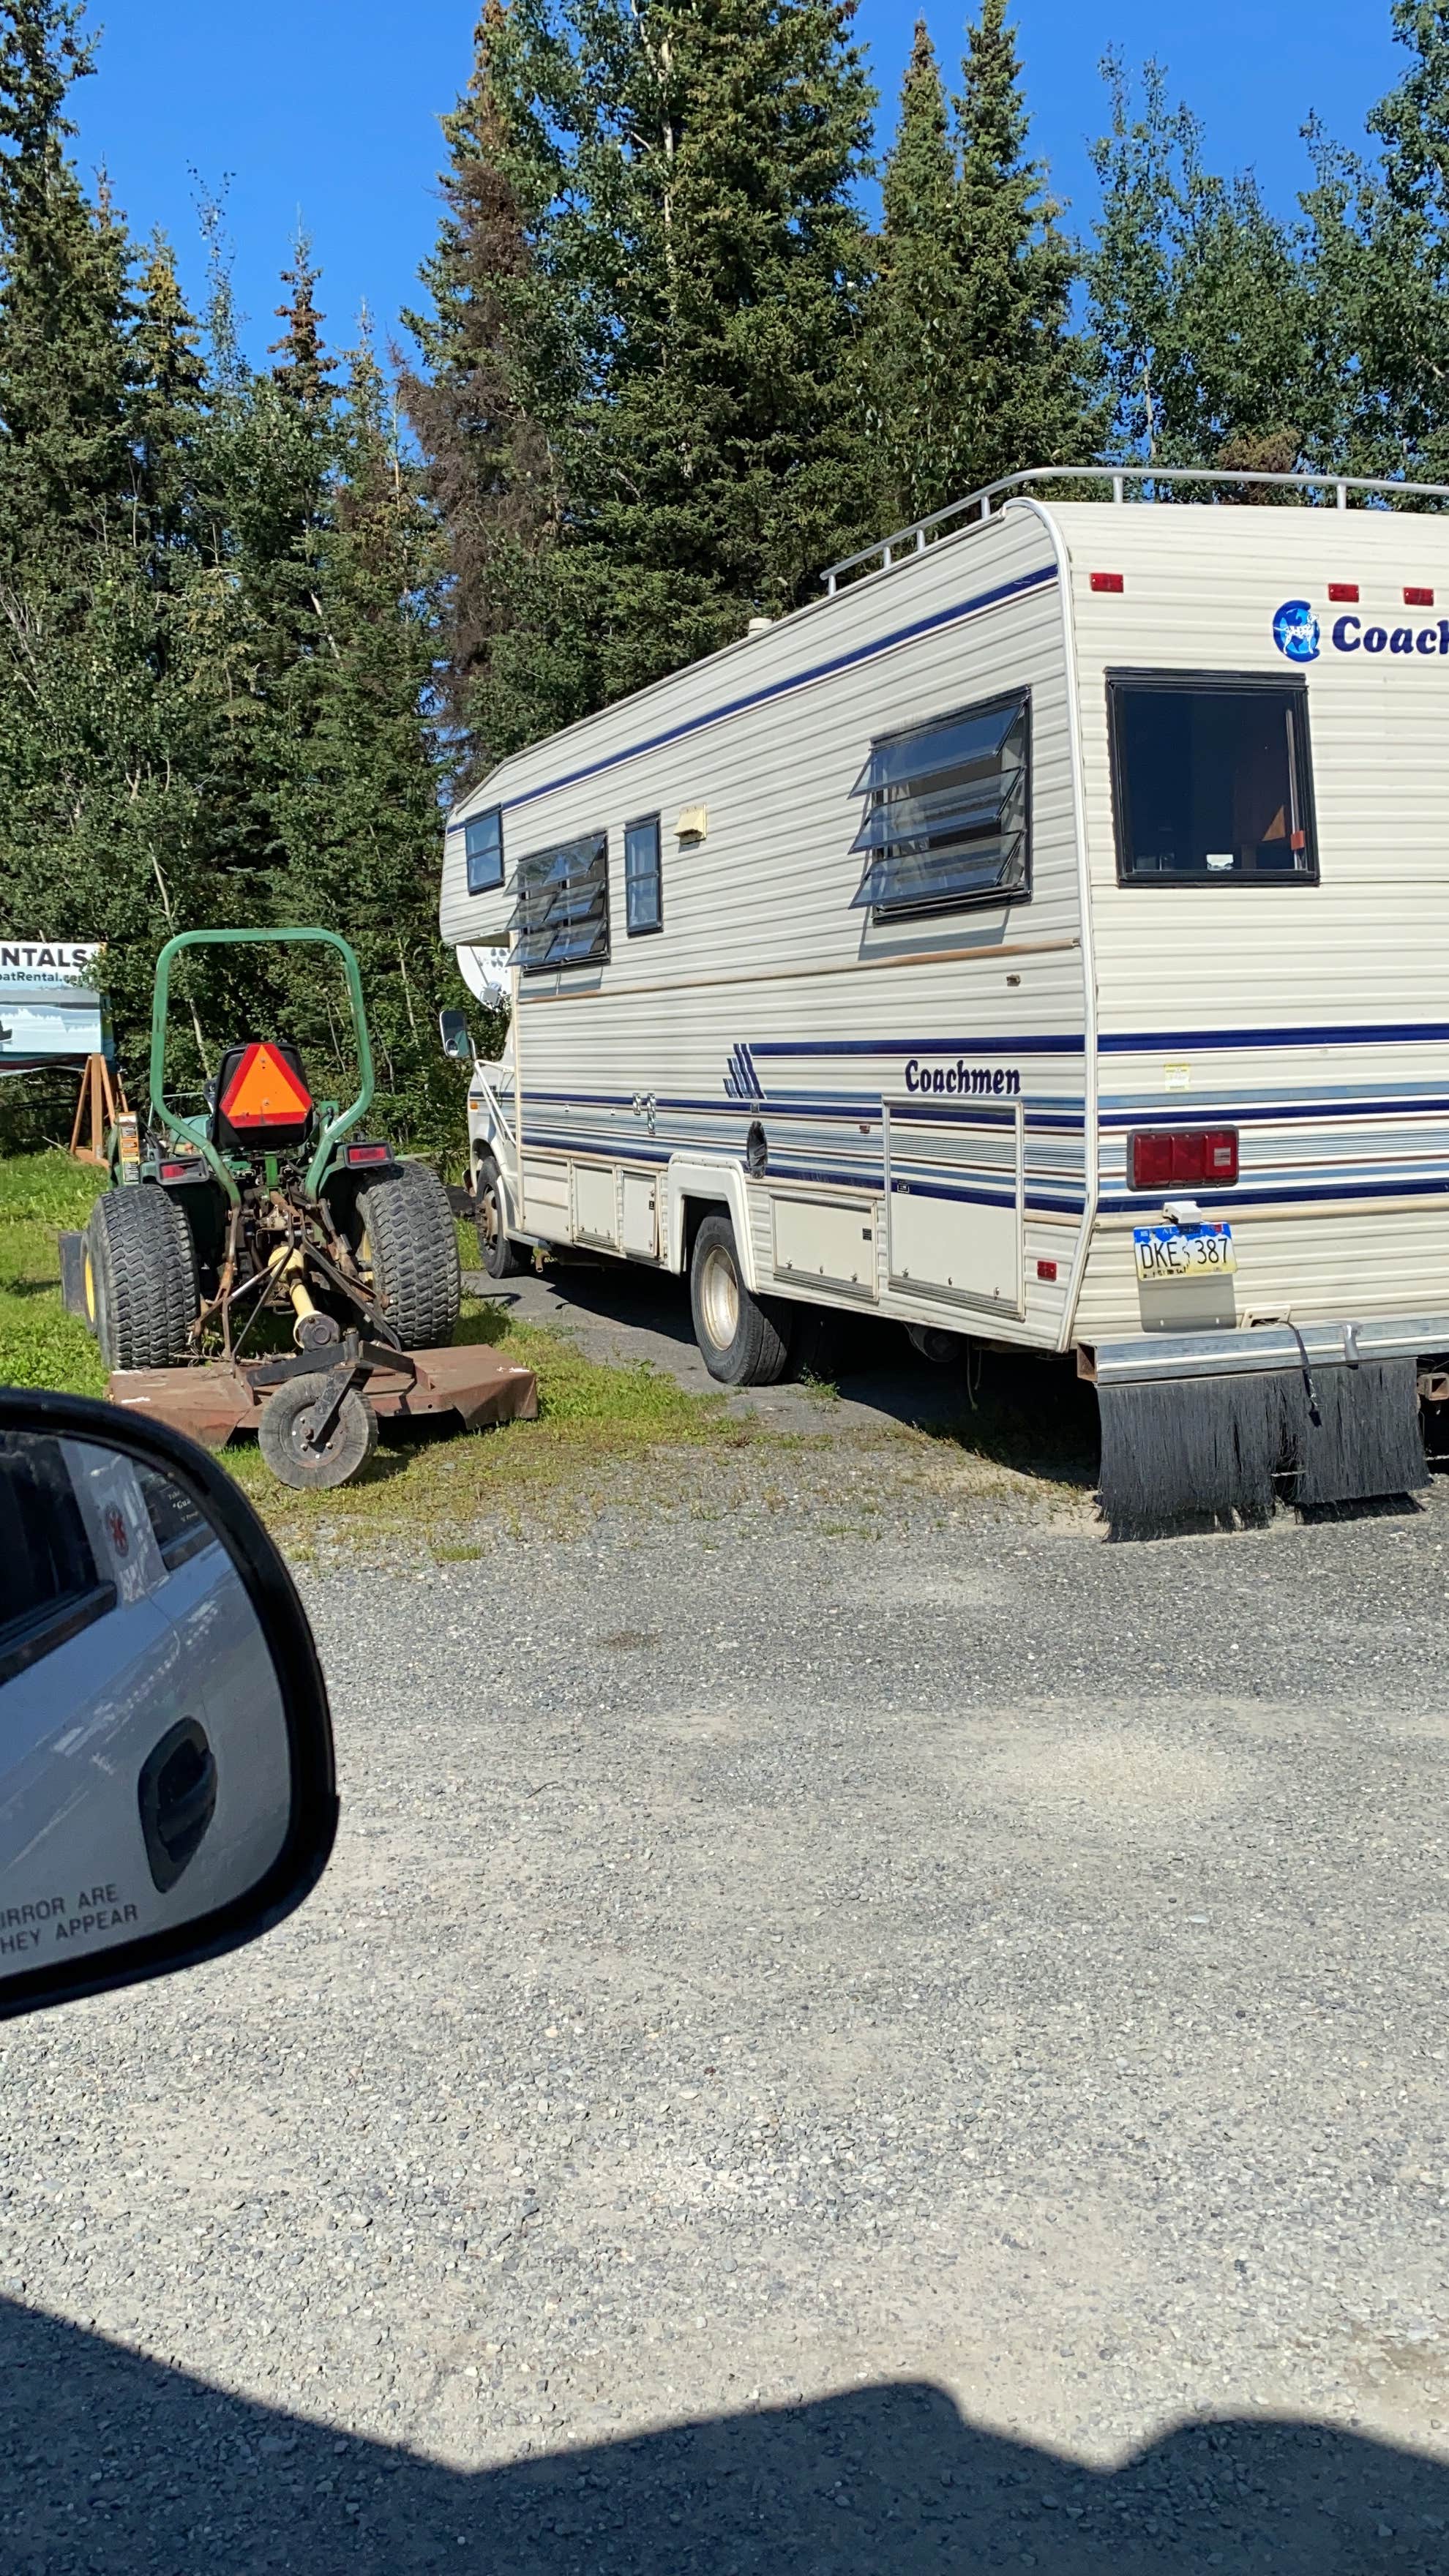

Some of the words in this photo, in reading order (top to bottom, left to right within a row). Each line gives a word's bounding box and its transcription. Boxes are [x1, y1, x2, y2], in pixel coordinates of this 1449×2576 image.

[905, 1059, 1021, 1094] Coachmen
[1140, 1241, 1180, 1269] DKE
[1194, 1238, 1228, 1264] 387
[0, 1896, 65, 1930] IRROR
[78, 1883, 119, 1909] ARE
[0, 1926, 41, 1955] HEY
[56, 1903, 138, 1940] APPEAR
